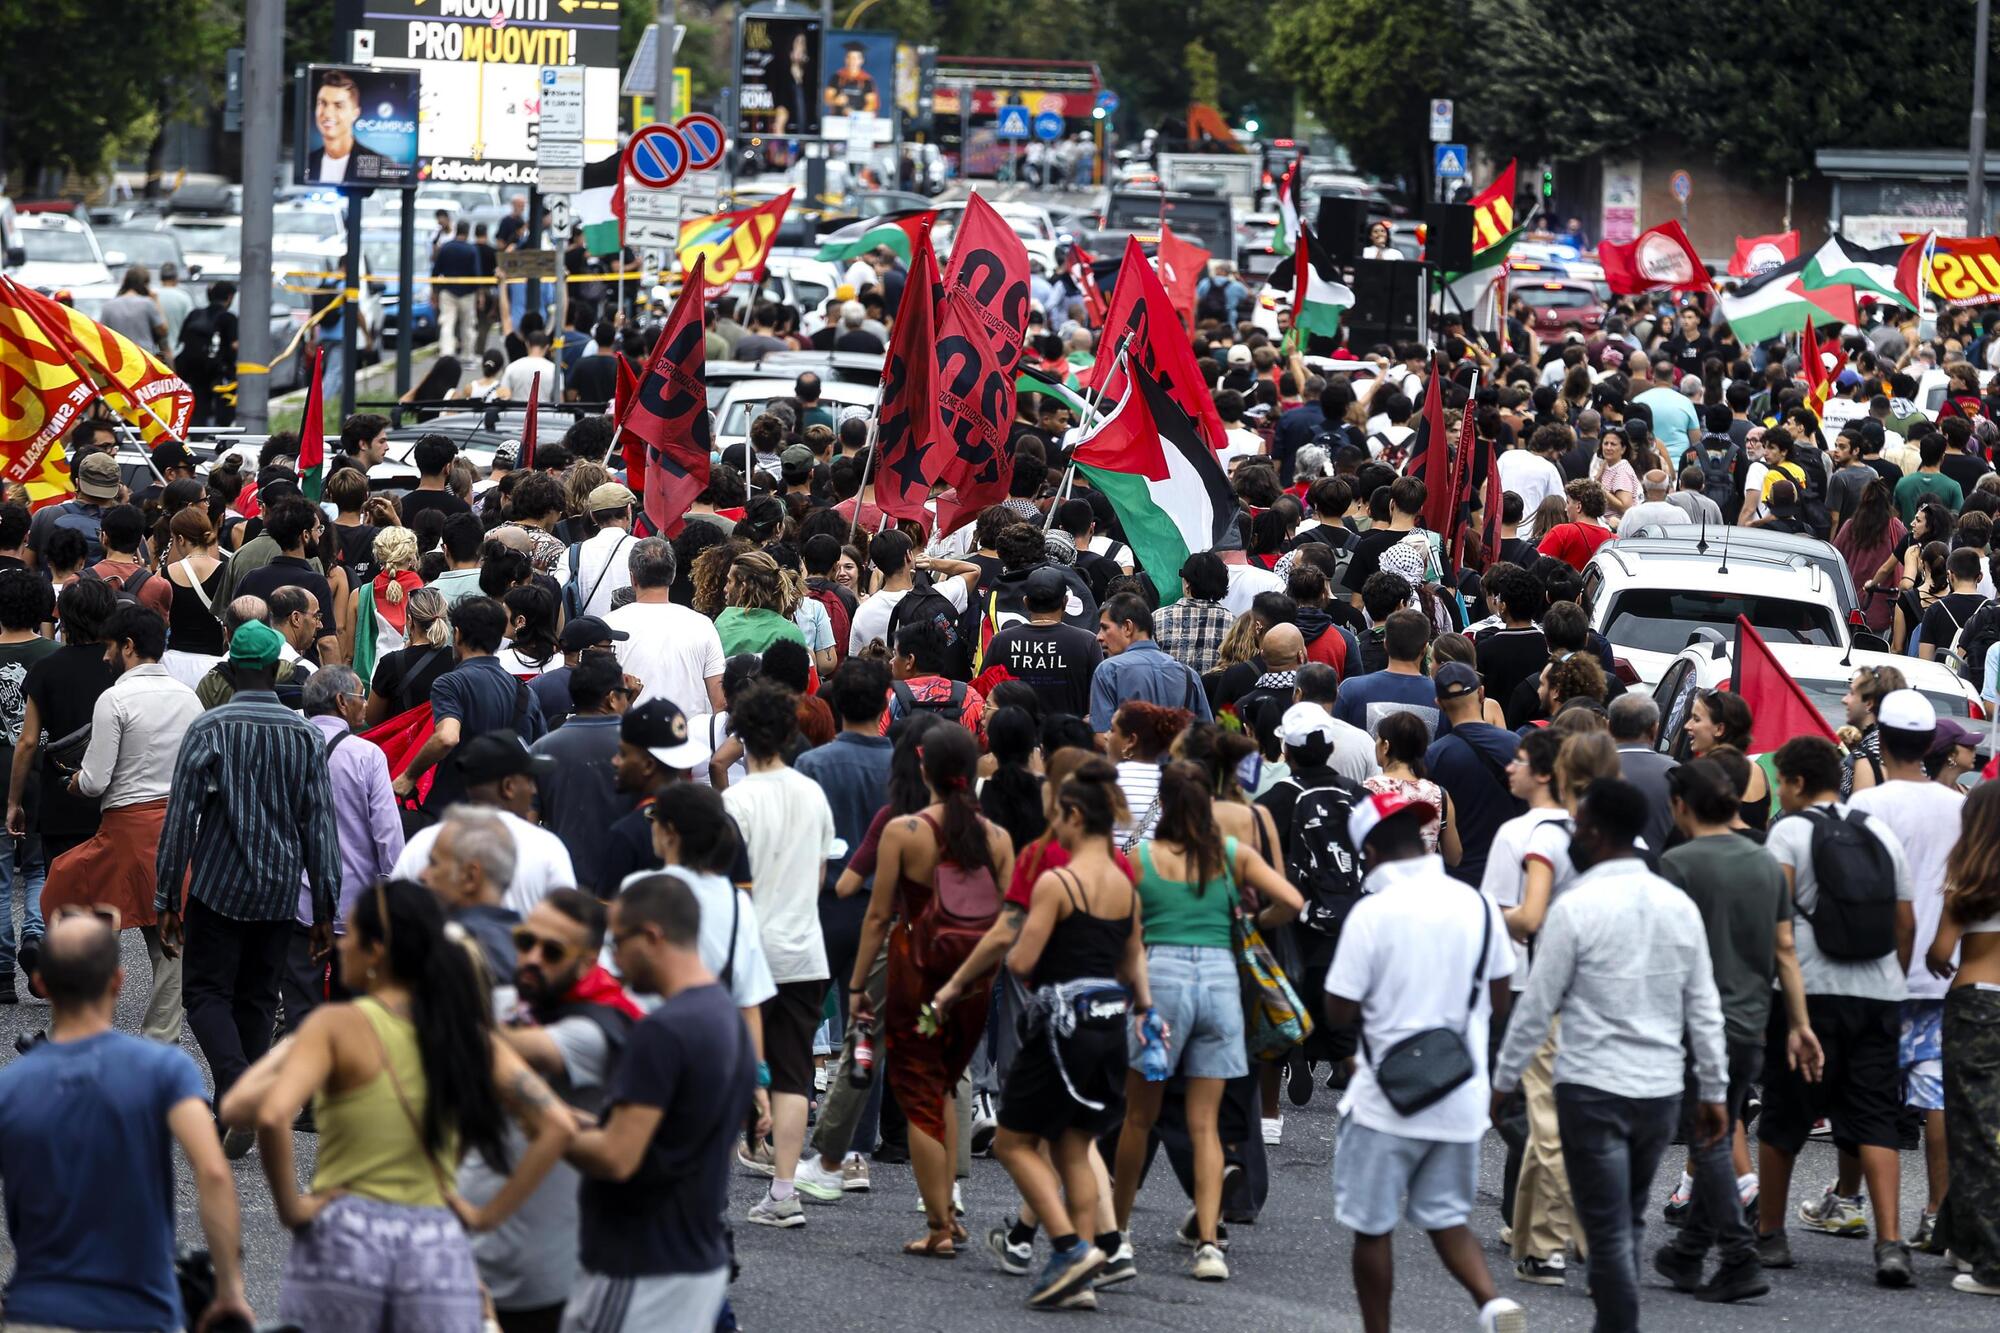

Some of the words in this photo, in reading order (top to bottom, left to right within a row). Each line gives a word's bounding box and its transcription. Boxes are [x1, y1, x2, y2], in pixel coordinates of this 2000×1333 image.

[408, 21, 577, 66] PROMUOVITI!
[1011, 640, 1057, 654] NIKE
[1011, 655, 1067, 669] TRAIL
